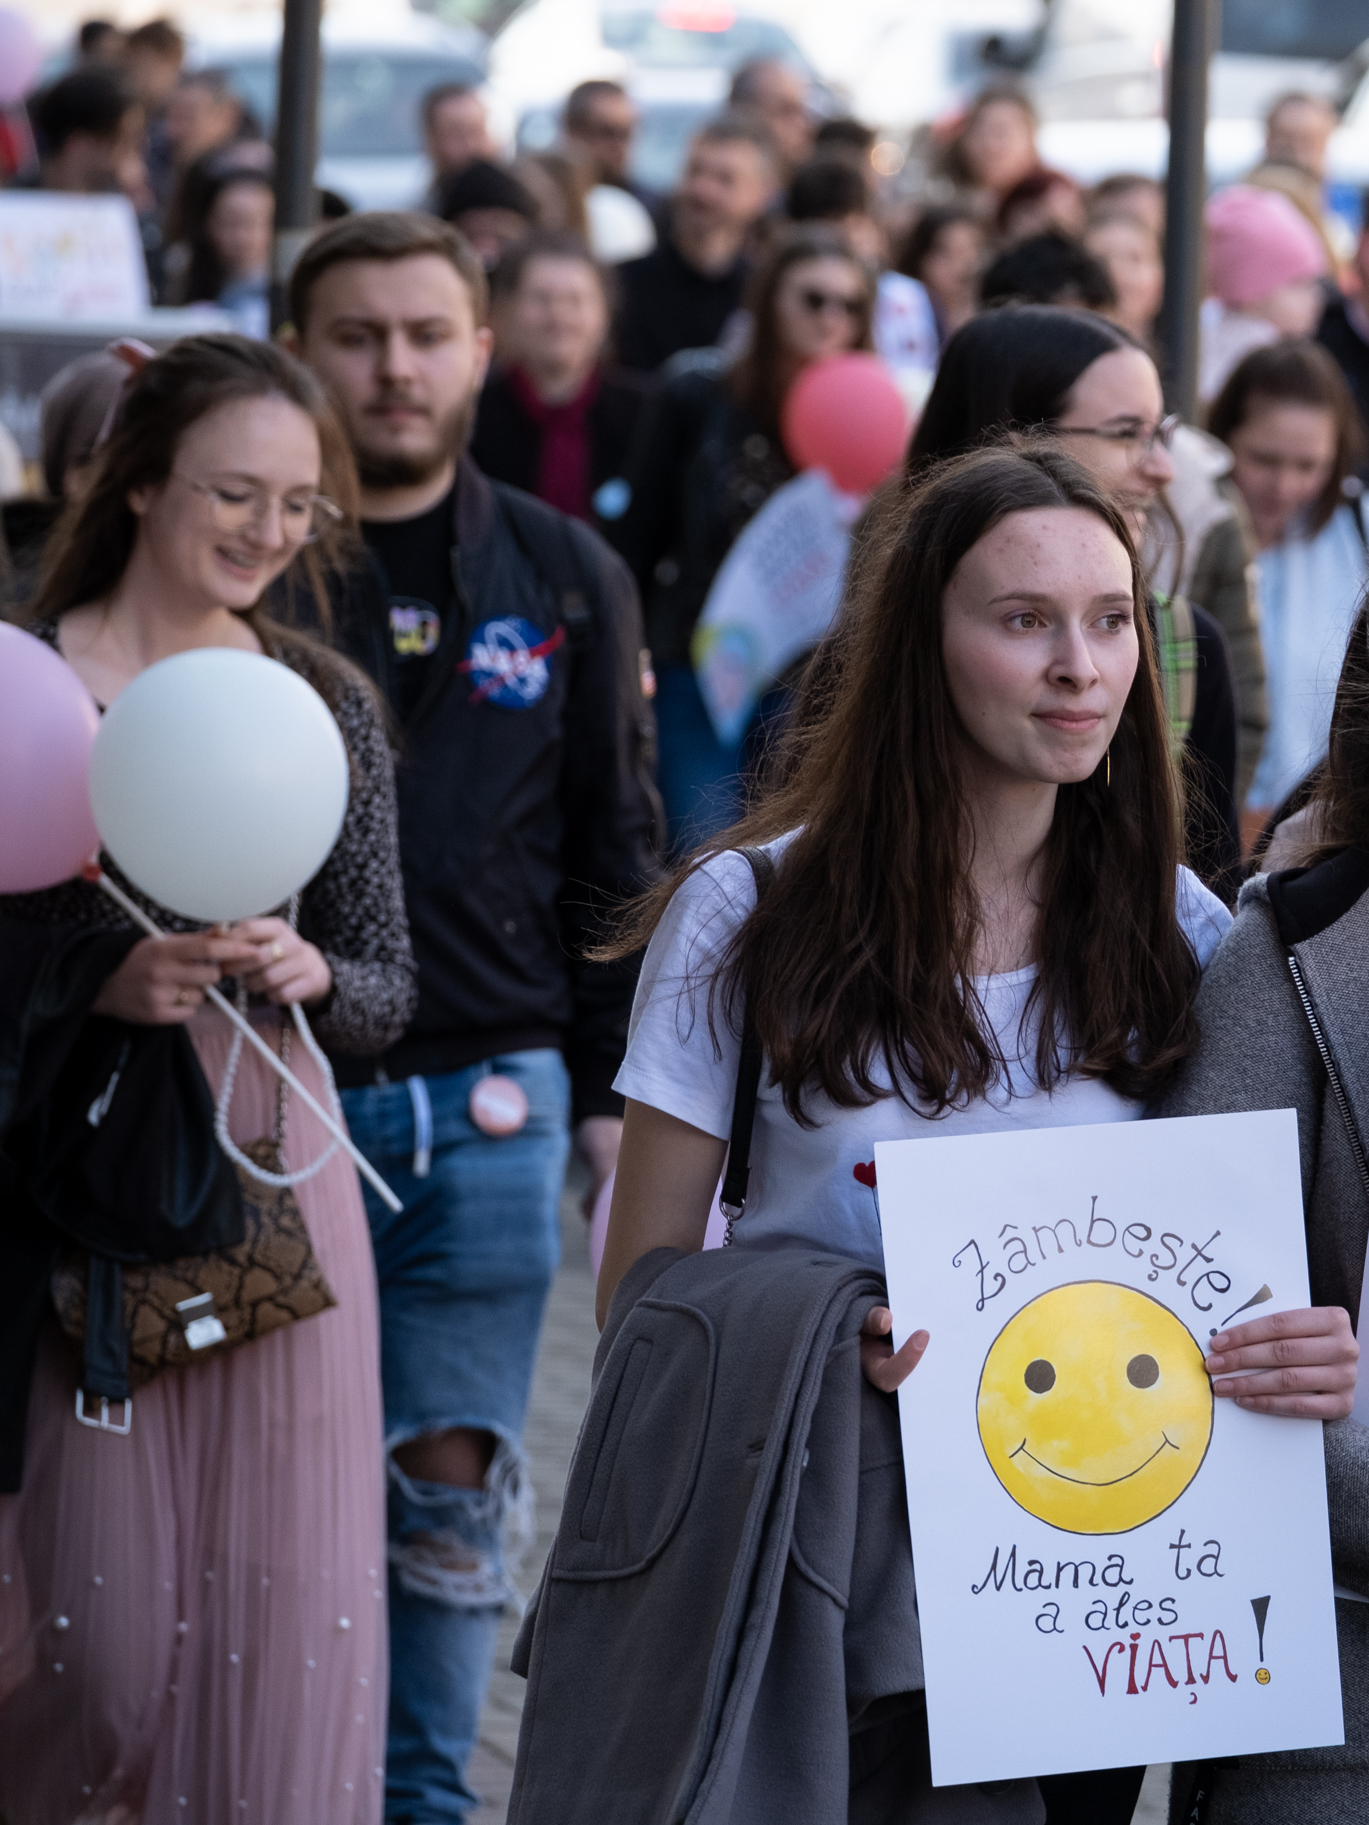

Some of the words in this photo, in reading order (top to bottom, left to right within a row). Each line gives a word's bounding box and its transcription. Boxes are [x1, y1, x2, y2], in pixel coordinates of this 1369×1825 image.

[971, 1545, 1134, 1596] Mama
[1169, 1529, 1226, 1580] ta
[1035, 1607, 1065, 1635] a
[1084, 1592, 1180, 1633] ales
